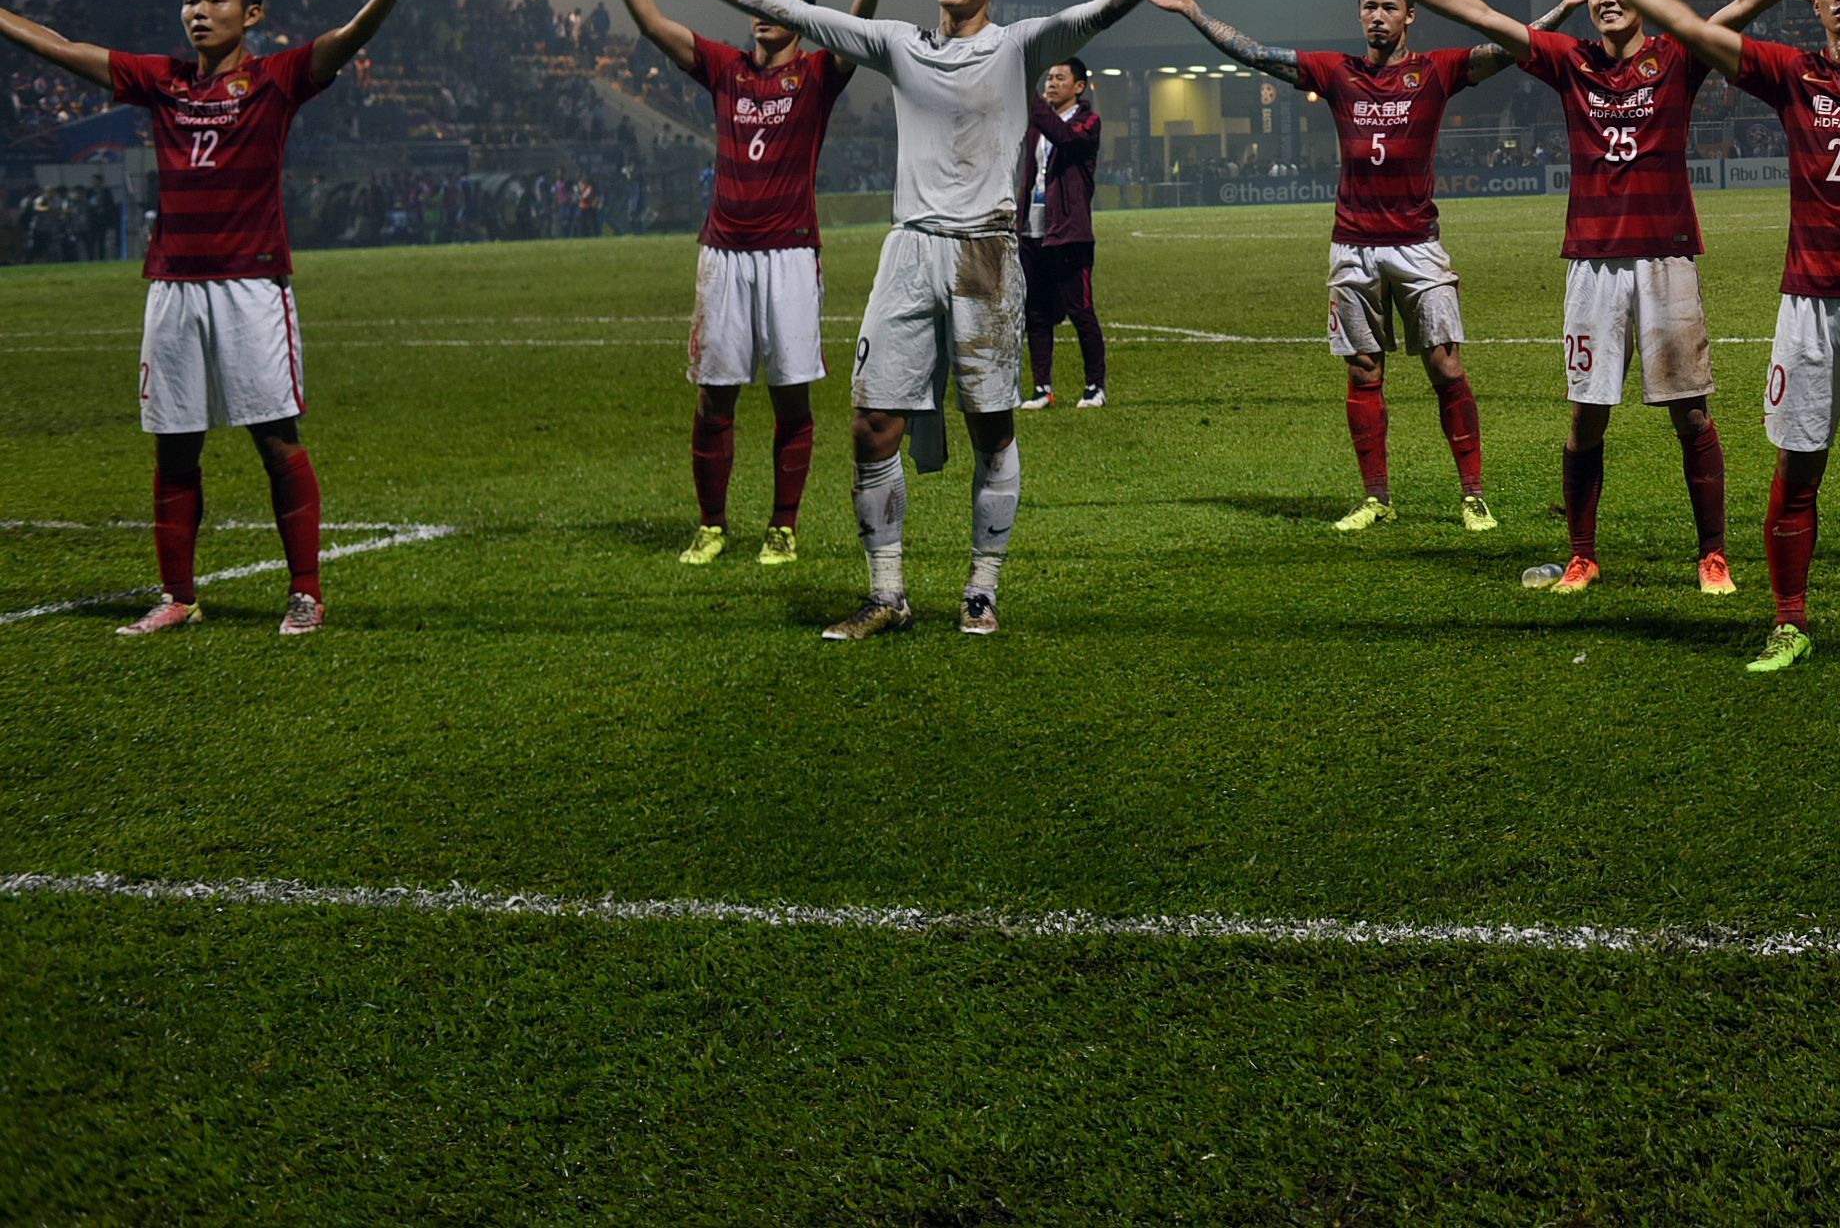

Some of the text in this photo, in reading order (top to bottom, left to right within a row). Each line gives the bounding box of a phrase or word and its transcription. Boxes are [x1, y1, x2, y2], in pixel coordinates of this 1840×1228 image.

[1353, 100, 1412, 117] 恒大金服
[1588, 87, 1654, 108] 恒大金服
[1589, 107, 1654, 119] HDFAX.COM
[1353, 116, 1408, 126] HDFAX.COM
[190, 129, 219, 167] 12
[748, 128, 766, 161] 6
[1370, 133, 1387, 166] 5
[1602, 126, 1638, 162] 25
[1730, 167, 1758, 181] Abu
[856, 336, 870, 376] 9
[1565, 334, 1593, 372] 25
